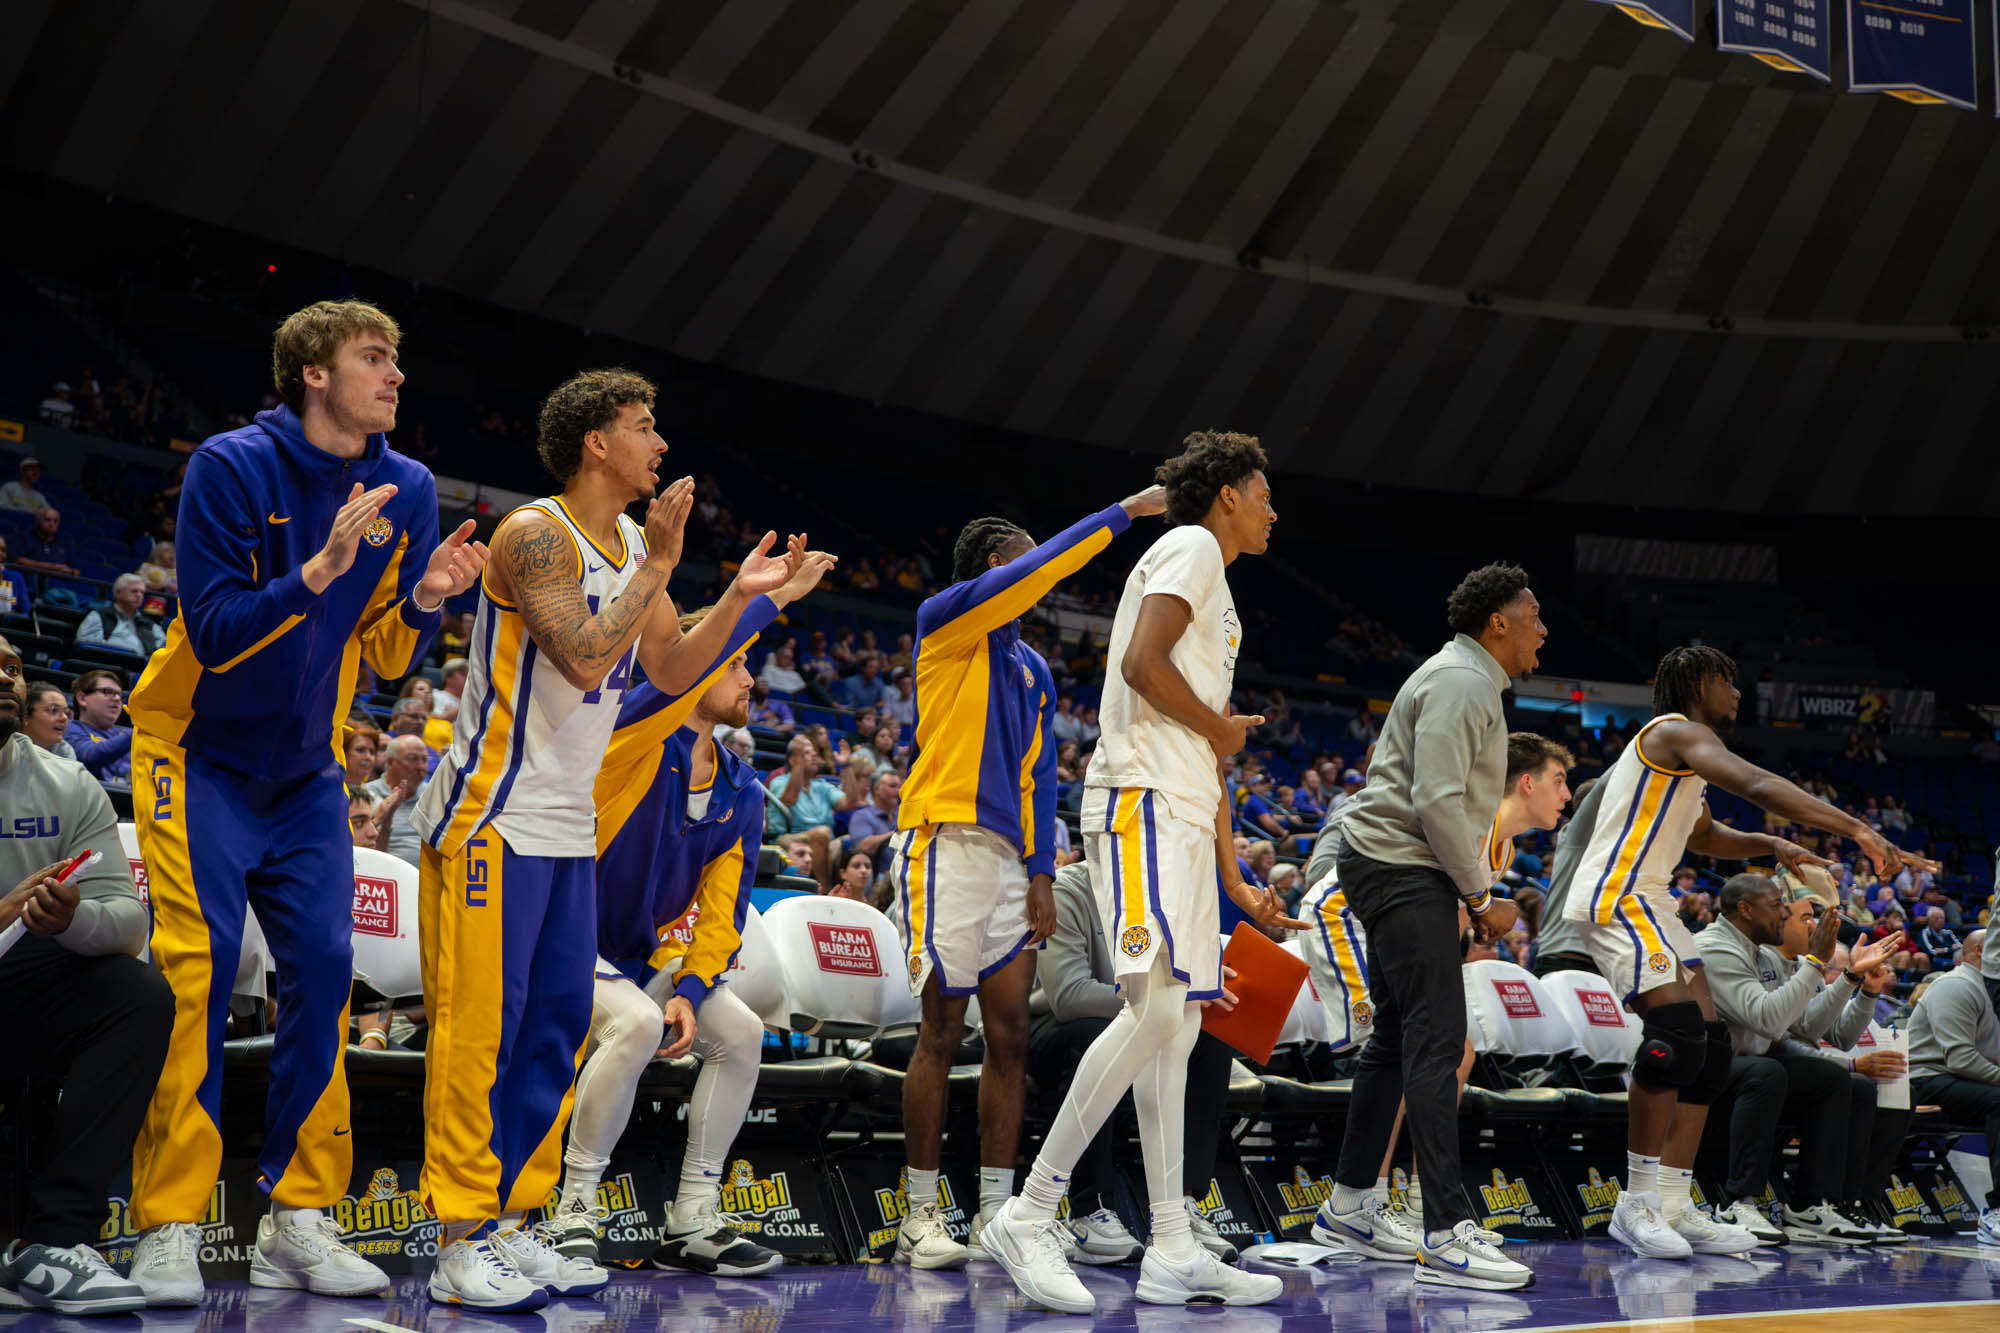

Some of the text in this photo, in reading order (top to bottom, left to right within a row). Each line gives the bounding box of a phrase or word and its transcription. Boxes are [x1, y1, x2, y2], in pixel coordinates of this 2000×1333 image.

[1802, 696, 1857, 717] WBRZ
[151, 757, 172, 820] LSU
[0, 815, 60, 839] LSU
[466, 839, 488, 907] LSU
[352, 896, 389, 914] EAU
[354, 915, 389, 928] RANCE
[830, 931, 868, 945] FARM
[819, 941, 872, 958] BUREAU
[831, 959, 875, 970] INSURANCE
[1482, 1179, 1530, 1210] Bengal
[335, 1196, 437, 1235] Benga
[616, 1211, 648, 1228] .com
[772, 1208, 801, 1224] .com
[763, 1223, 825, 1238] G.O.N.E.
[868, 1228, 899, 1249] KEEP
[356, 1240, 401, 1255] PESTS
